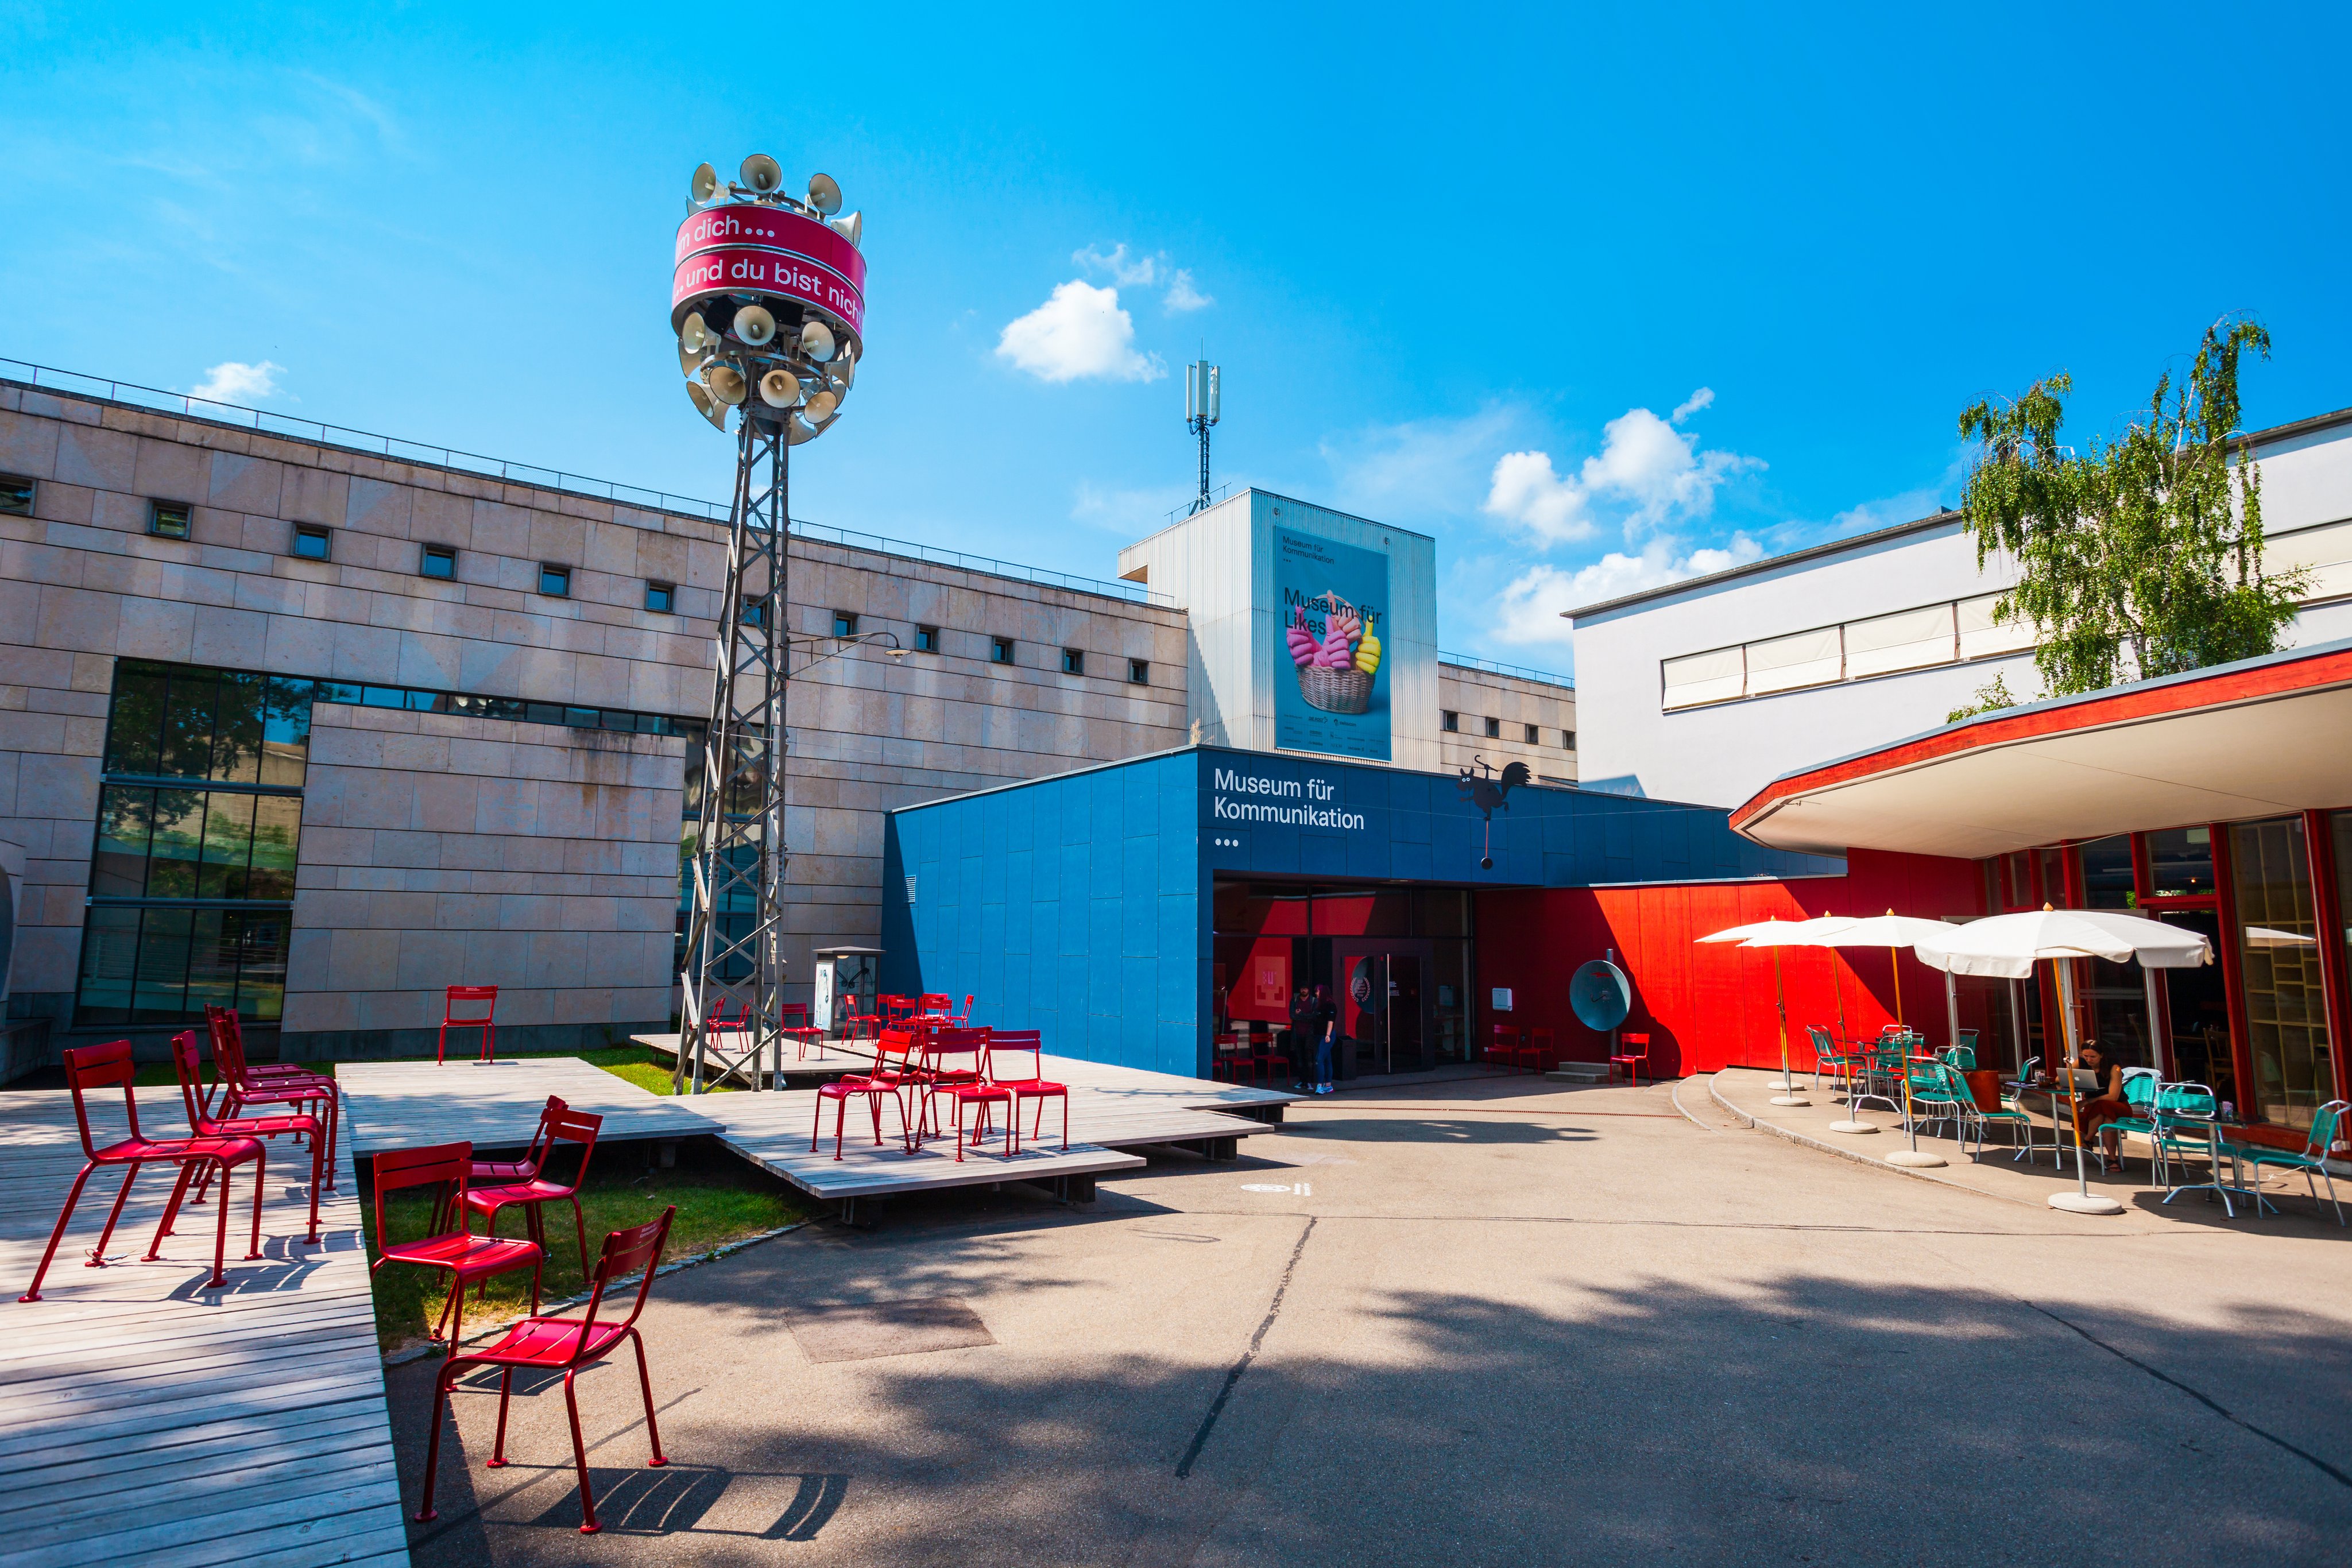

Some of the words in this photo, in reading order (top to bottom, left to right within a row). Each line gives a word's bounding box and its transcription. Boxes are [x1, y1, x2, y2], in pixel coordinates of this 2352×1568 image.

[731, 258, 764, 280] du
[775, 262, 822, 296] bist
[829, 287, 862, 330] nicht
[1283, 536, 1312, 549] Museum
[1314, 544, 1324, 552] für
[1283, 545, 1334, 564] Kommunikation
[1285, 587, 1355, 619] Museum
[1359, 605, 1382, 624] für
[1285, 610, 1326, 635] Likes
[1215, 768, 1301, 797] Museum
[1307, 779, 1334, 801] für
[1215, 796, 1364, 830] Kommunikation
